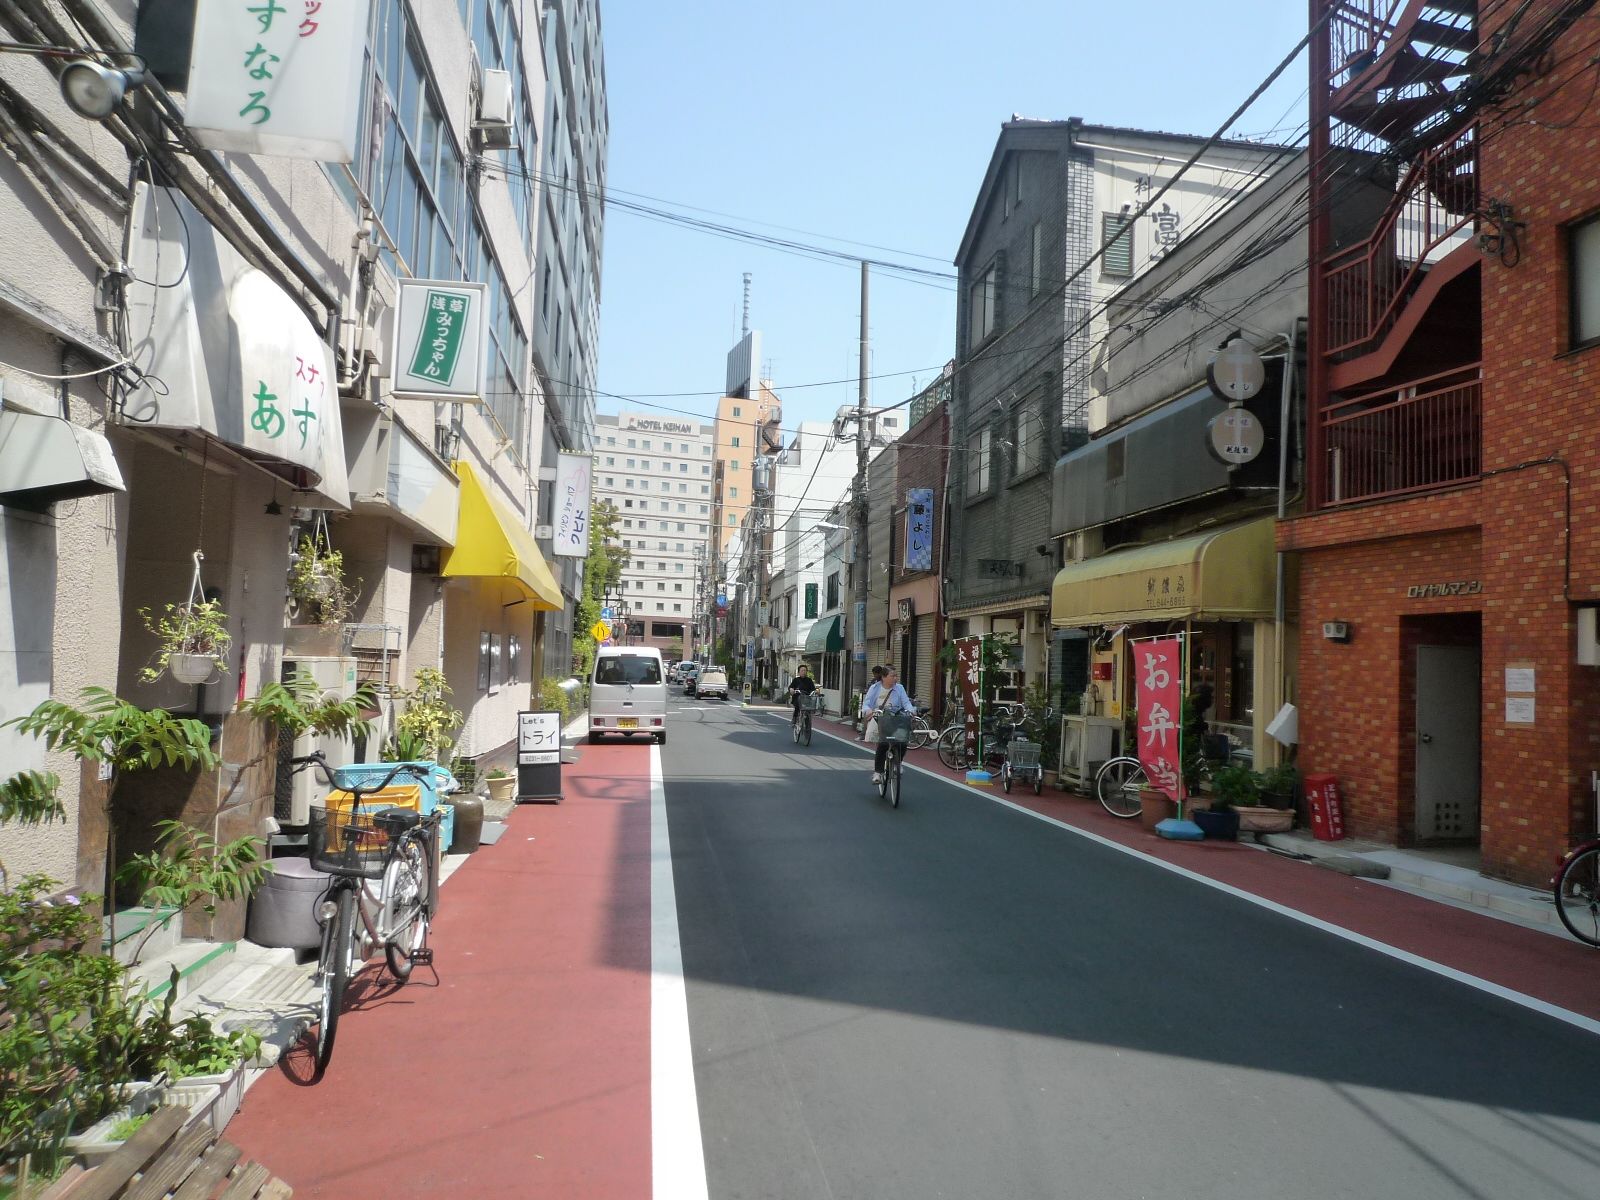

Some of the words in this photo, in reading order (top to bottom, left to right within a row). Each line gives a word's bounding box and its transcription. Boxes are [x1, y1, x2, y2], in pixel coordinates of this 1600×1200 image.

[431, 295, 464, 313] 浅草
[424, 312, 453, 376] みっちゃん
[637, 420, 662, 431] HOTEL
[663, 422, 692, 434] KEIHAN
[522, 717, 545, 725] Let's
[1142, 652, 1178, 791] お弁当
[523, 730, 556, 746] トライ
